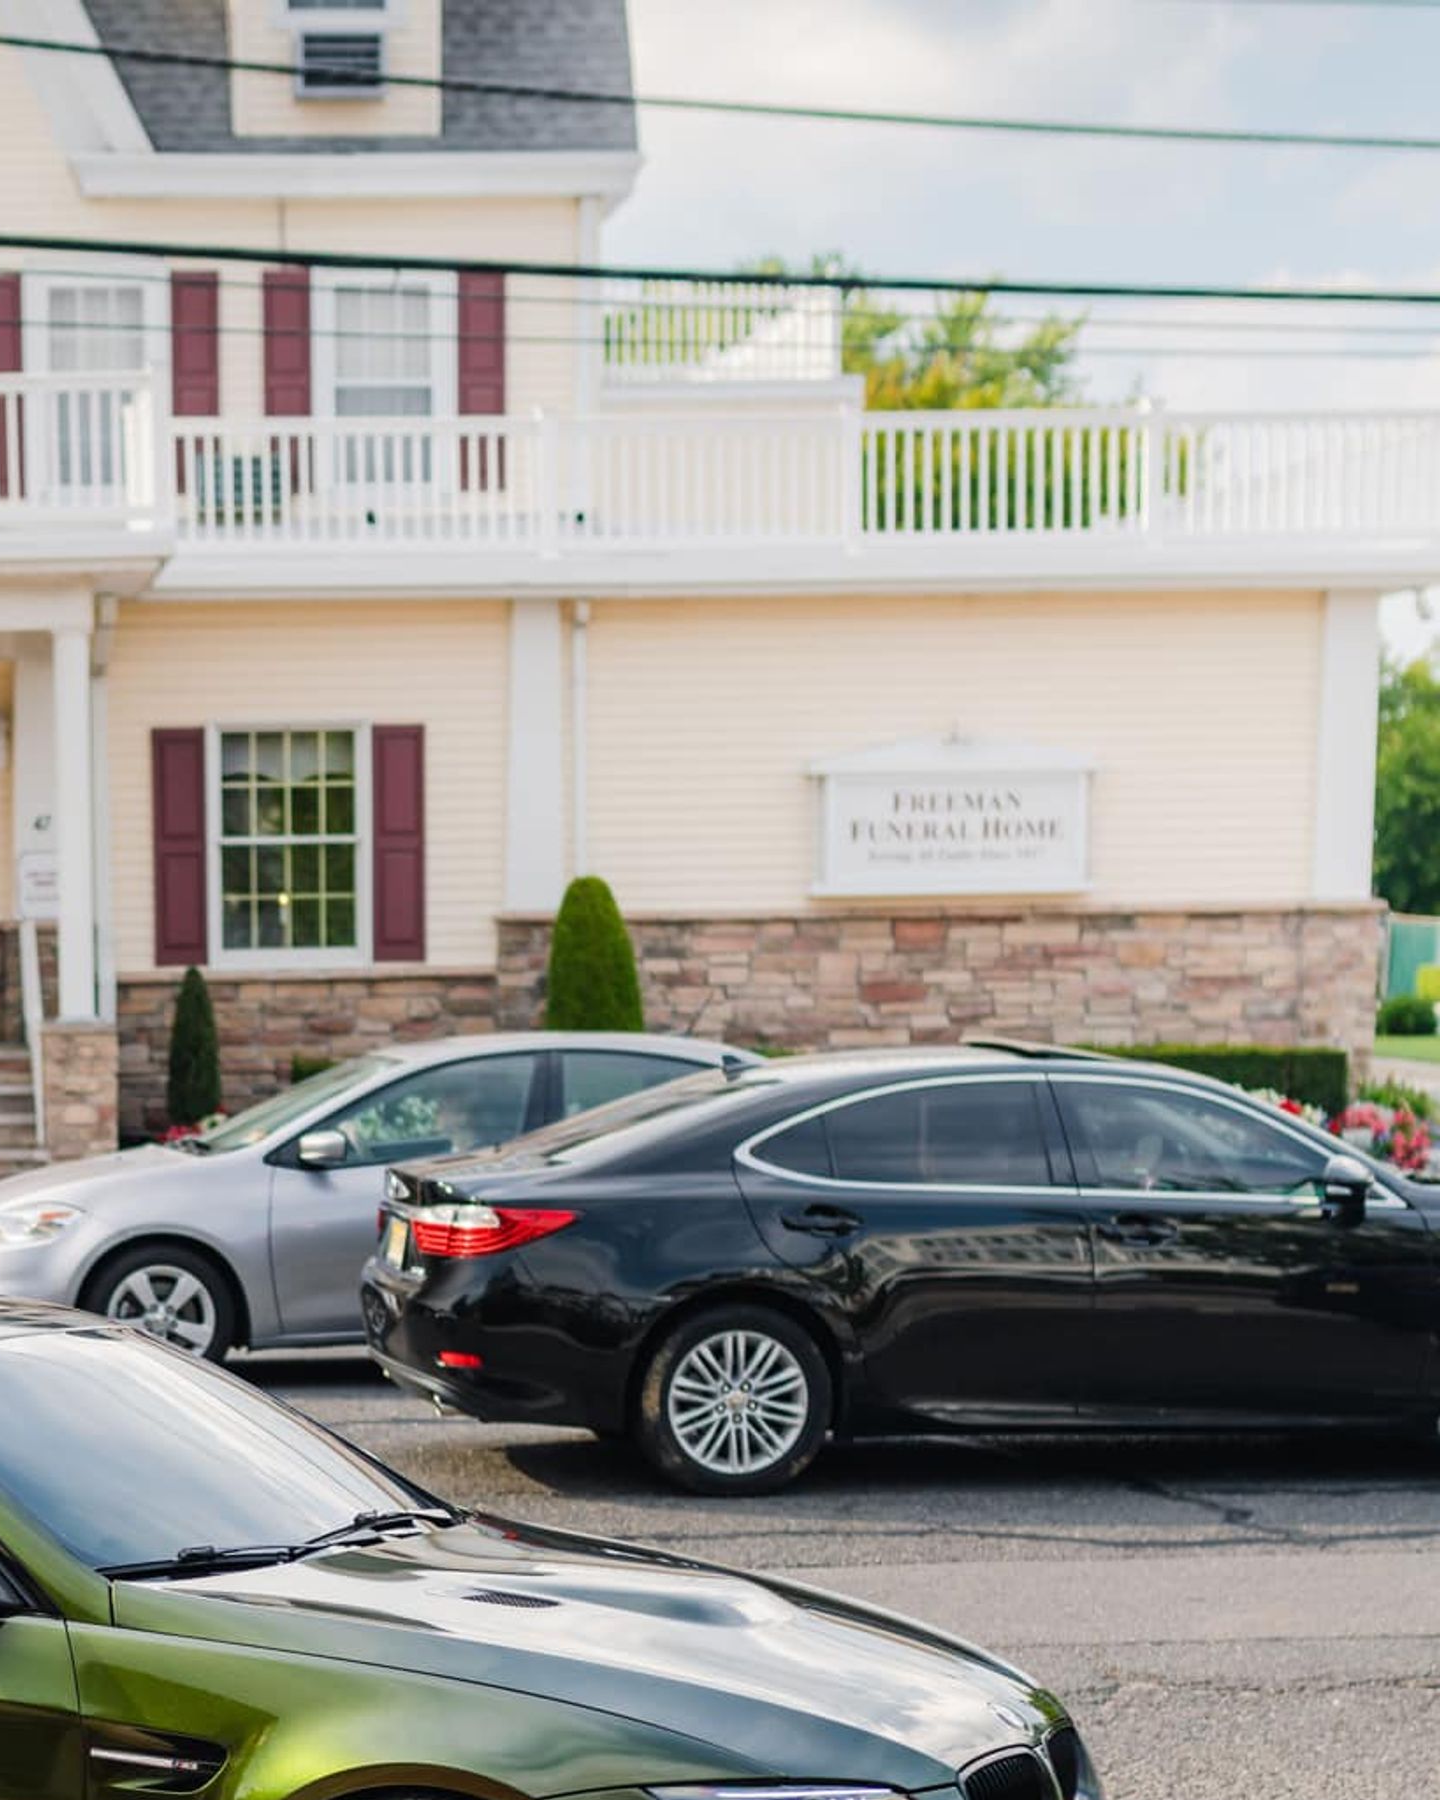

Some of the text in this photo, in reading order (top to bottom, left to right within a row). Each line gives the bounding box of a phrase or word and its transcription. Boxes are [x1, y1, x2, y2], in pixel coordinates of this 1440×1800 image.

[892, 791, 1022, 813] FREEMAN
[849, 818, 1060, 843] FUNERAL HOME
